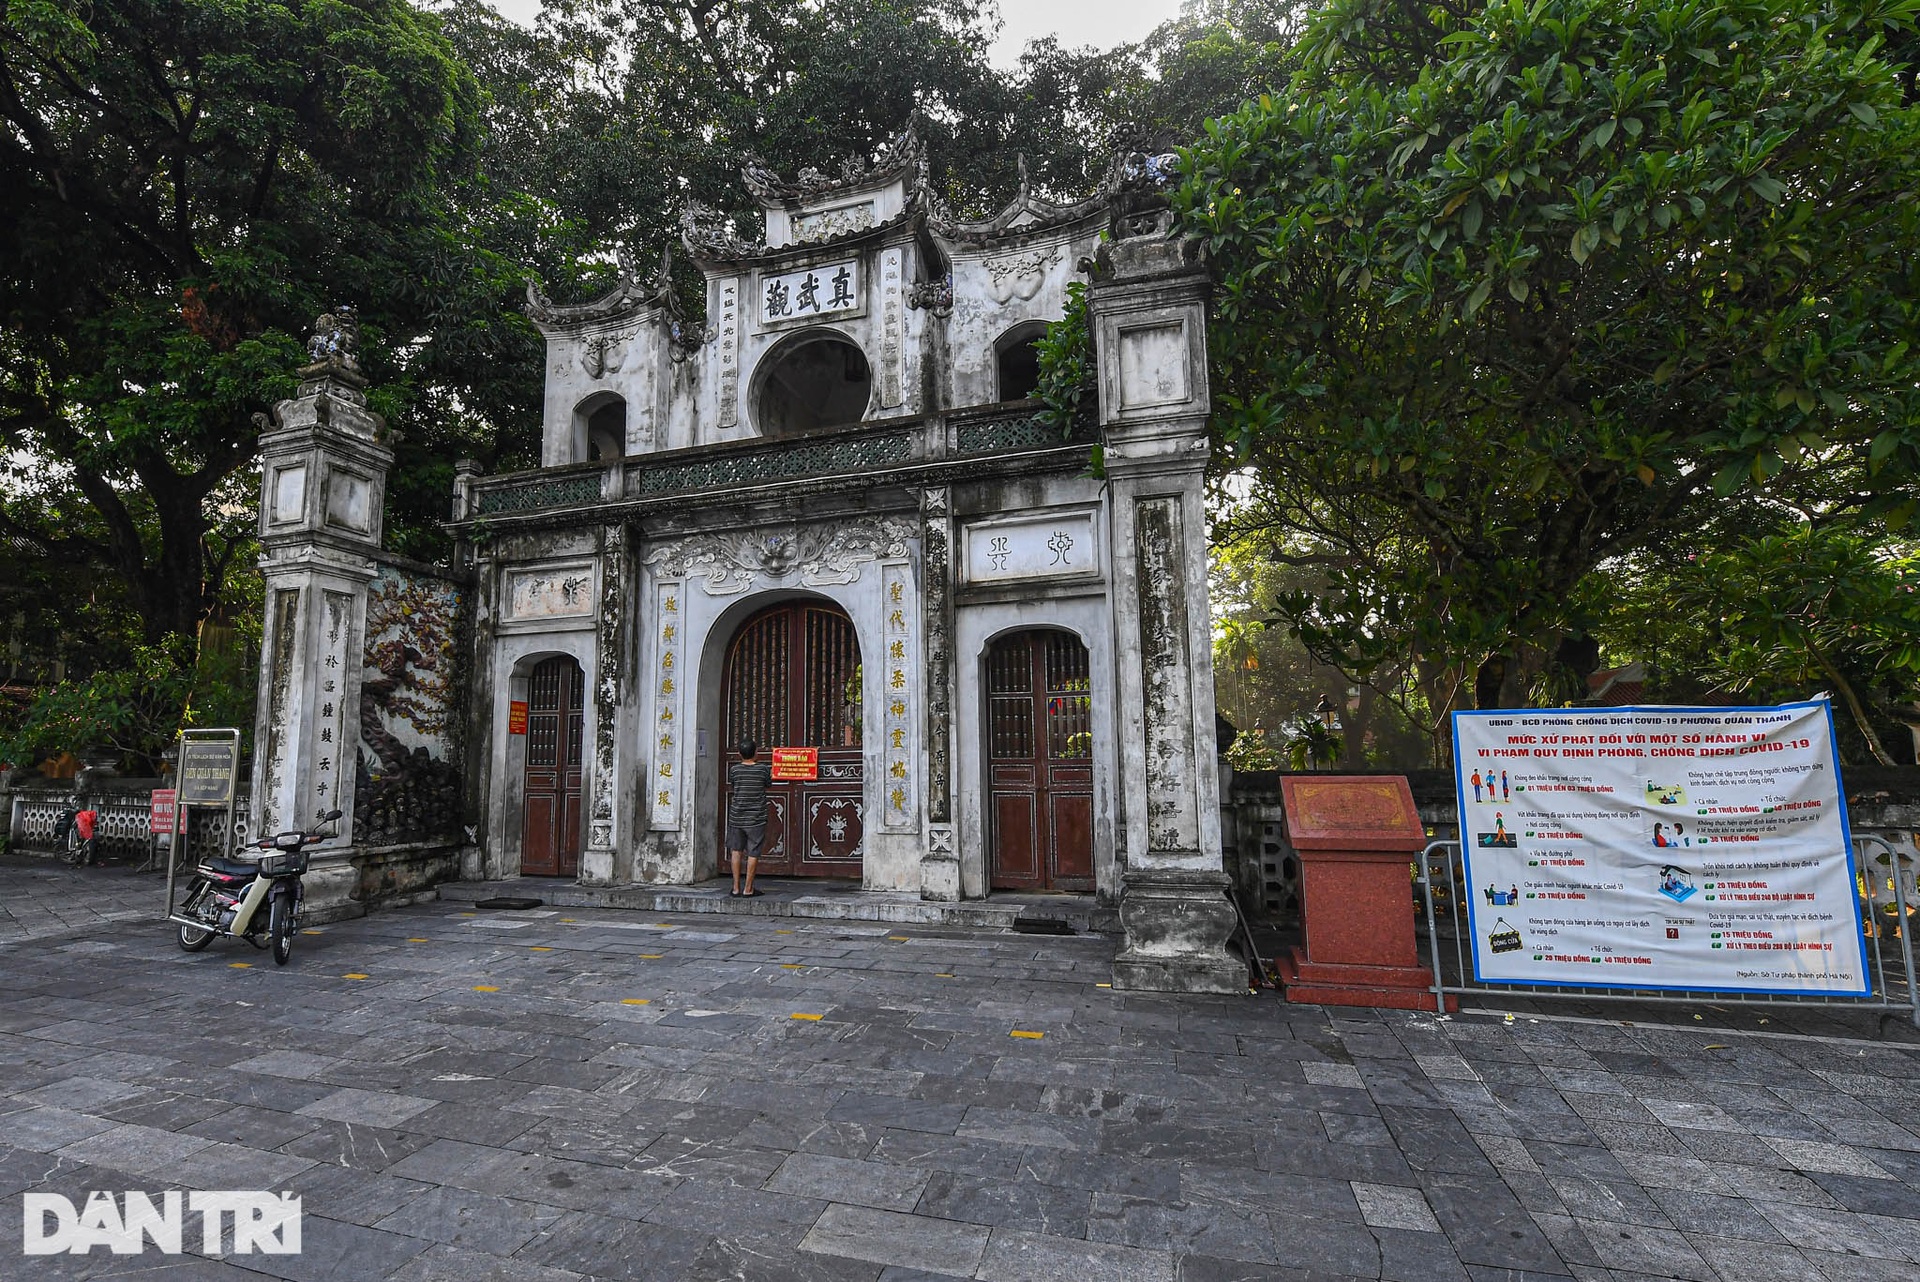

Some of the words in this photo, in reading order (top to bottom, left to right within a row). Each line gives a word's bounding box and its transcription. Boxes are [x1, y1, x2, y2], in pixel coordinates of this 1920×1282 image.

[1543, 717, 1573, 726] PHÒNG
[1576, 716, 1607, 725] CHỐNG
[1610, 718, 1633, 726] DỊCH
[1635, 717, 1678, 725] COVID-19
[1680, 716, 1721, 725] PHƯỜNG
[1724, 715, 1752, 725] QUÁN
[1756, 714, 1792, 724] THÁNH
[1508, 733, 1537, 744] MỨC
[1541, 732, 1559, 744] XỬ
[1562, 735, 1595, 746] PHẠT
[1599, 732, 1622, 743] ĐỐI
[1626, 732, 1646, 743] VỚI
[1649, 733, 1678, 745] MỘT
[1682, 731, 1702, 743] SỐ
[1705, 732, 1747, 743] HÀNH
[1751, 733, 1766, 742] VI
[1478, 748, 1490, 757] VI
[1493, 748, 1529, 759] PHẠM
[1533, 748, 1558, 758] QUY
[1562, 748, 1594, 759] ĐỊNH
[1598, 746, 1647, 758] PHÒNG,
[1651, 745, 1695, 757] CHỐNG
[1700, 747, 1735, 758] DỊCH
[1739, 738, 1810, 755] COVID-19
